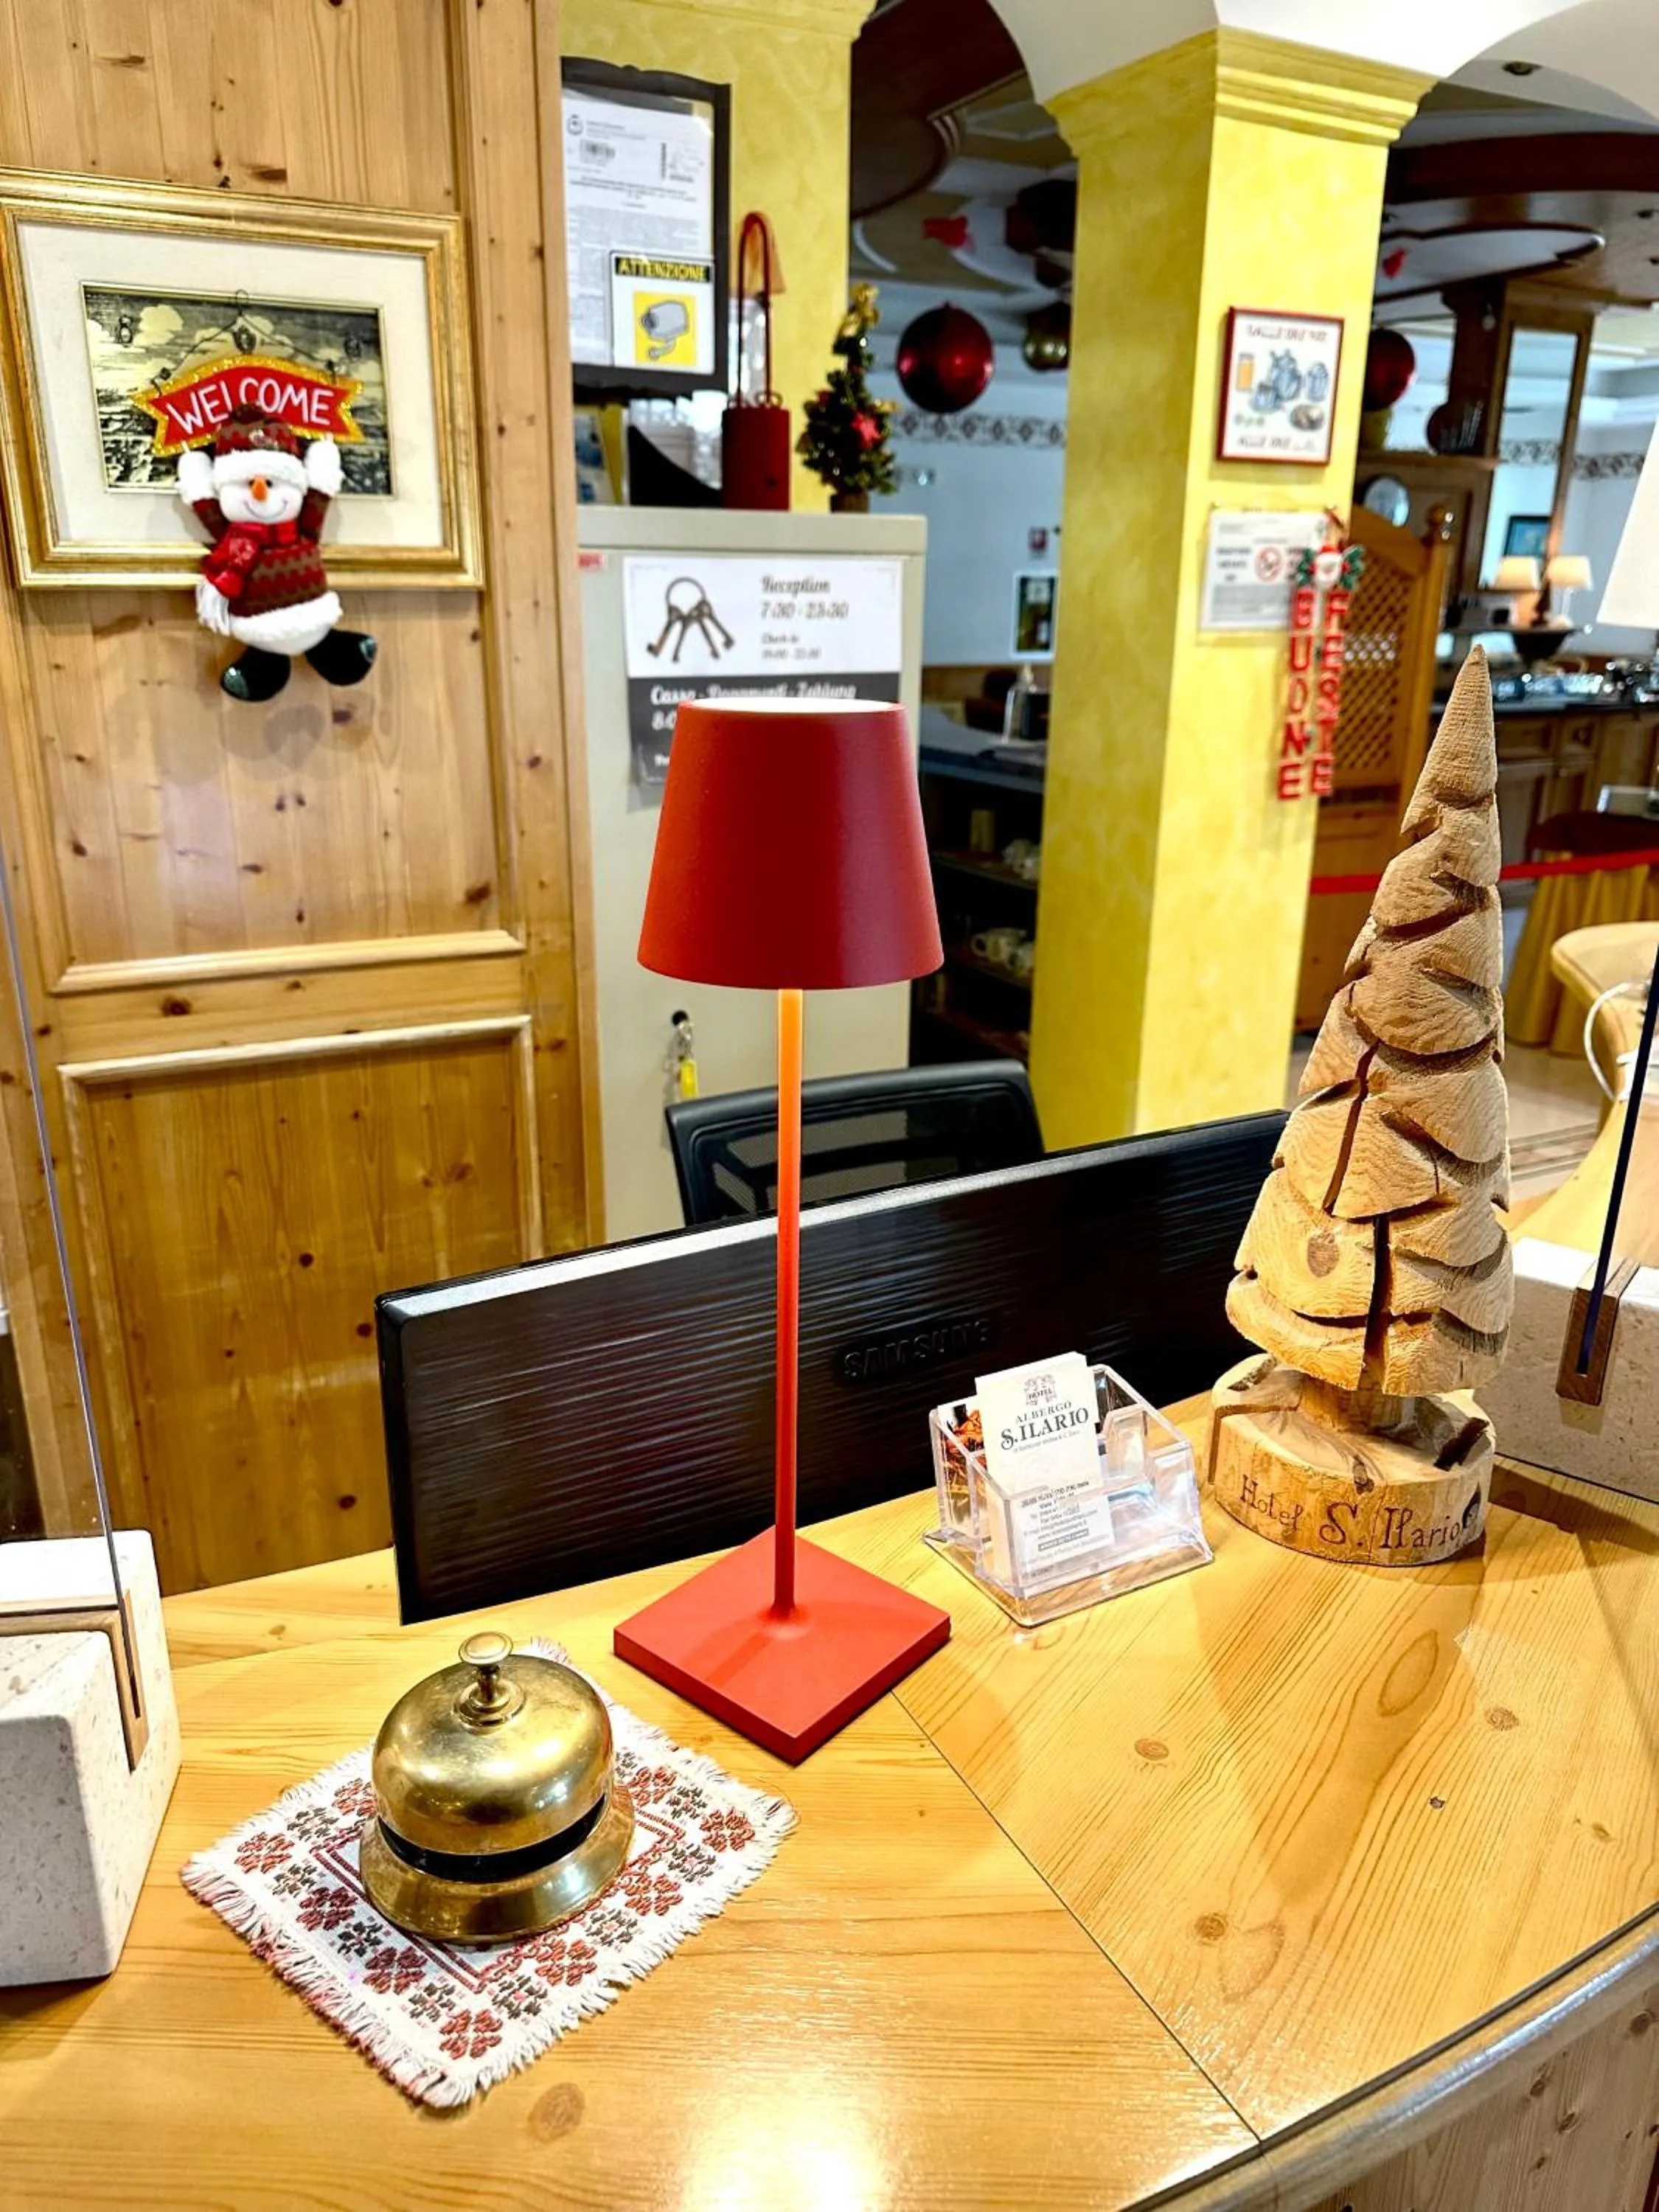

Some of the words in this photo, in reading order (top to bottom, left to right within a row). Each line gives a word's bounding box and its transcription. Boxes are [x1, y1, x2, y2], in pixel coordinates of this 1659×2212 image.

[618, 259, 706, 281] ATTENZIONE
[167, 378, 335, 435] WELCOME
[761, 575, 831, 599] Reception
[1276, 589, 1315, 800] BUONE
[1310, 591, 1351, 796] FESTE
[1016, 1400, 1071, 1423] ALBERGO
[1239, 1474, 1304, 1533] Hotel
[1319, 1501, 1364, 1547] S.
[1379, 1506, 1461, 1549] Ilario
